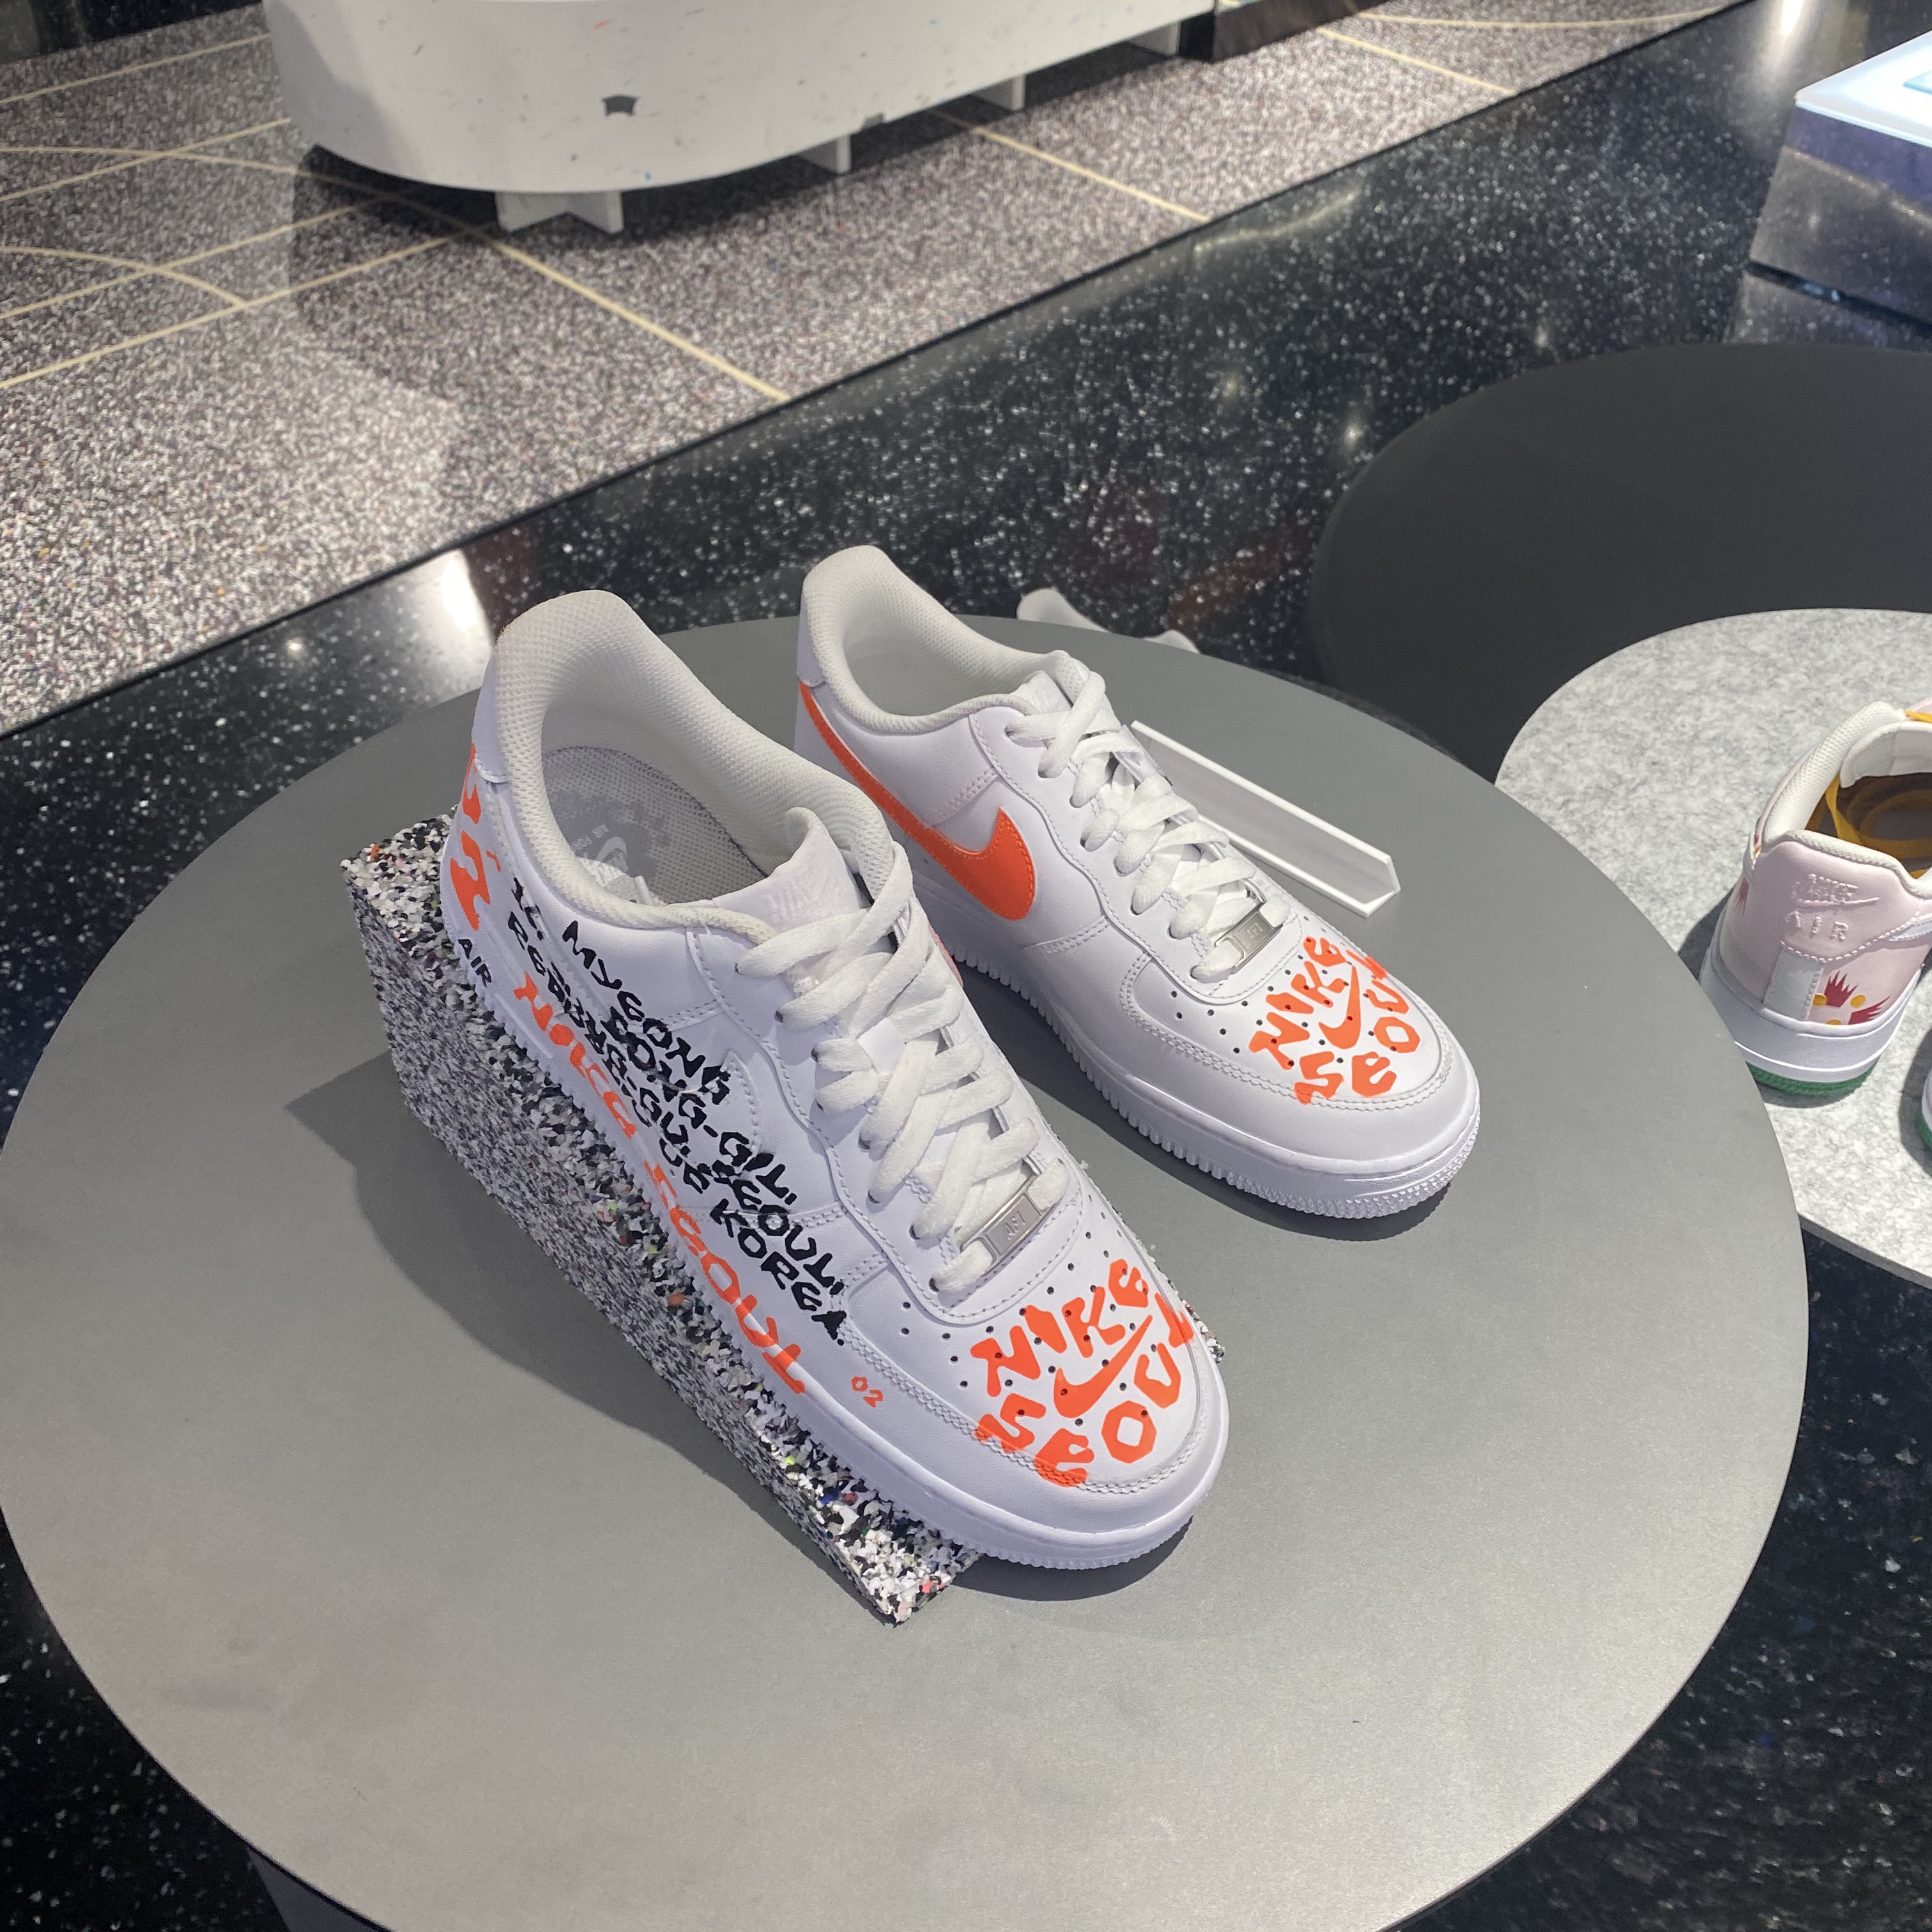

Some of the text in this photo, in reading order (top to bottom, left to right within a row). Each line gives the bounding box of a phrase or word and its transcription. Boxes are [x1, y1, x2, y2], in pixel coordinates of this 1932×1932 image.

[457, 939, 493, 988] AIR
[1248, 935, 1348, 1070] NIKE
[1294, 949, 1421, 1105] SEOUL
[850, 1375, 884, 1409] 02
[969, 1258, 1149, 1397] NIKE
[974, 1292, 1194, 1487] SEOUL
